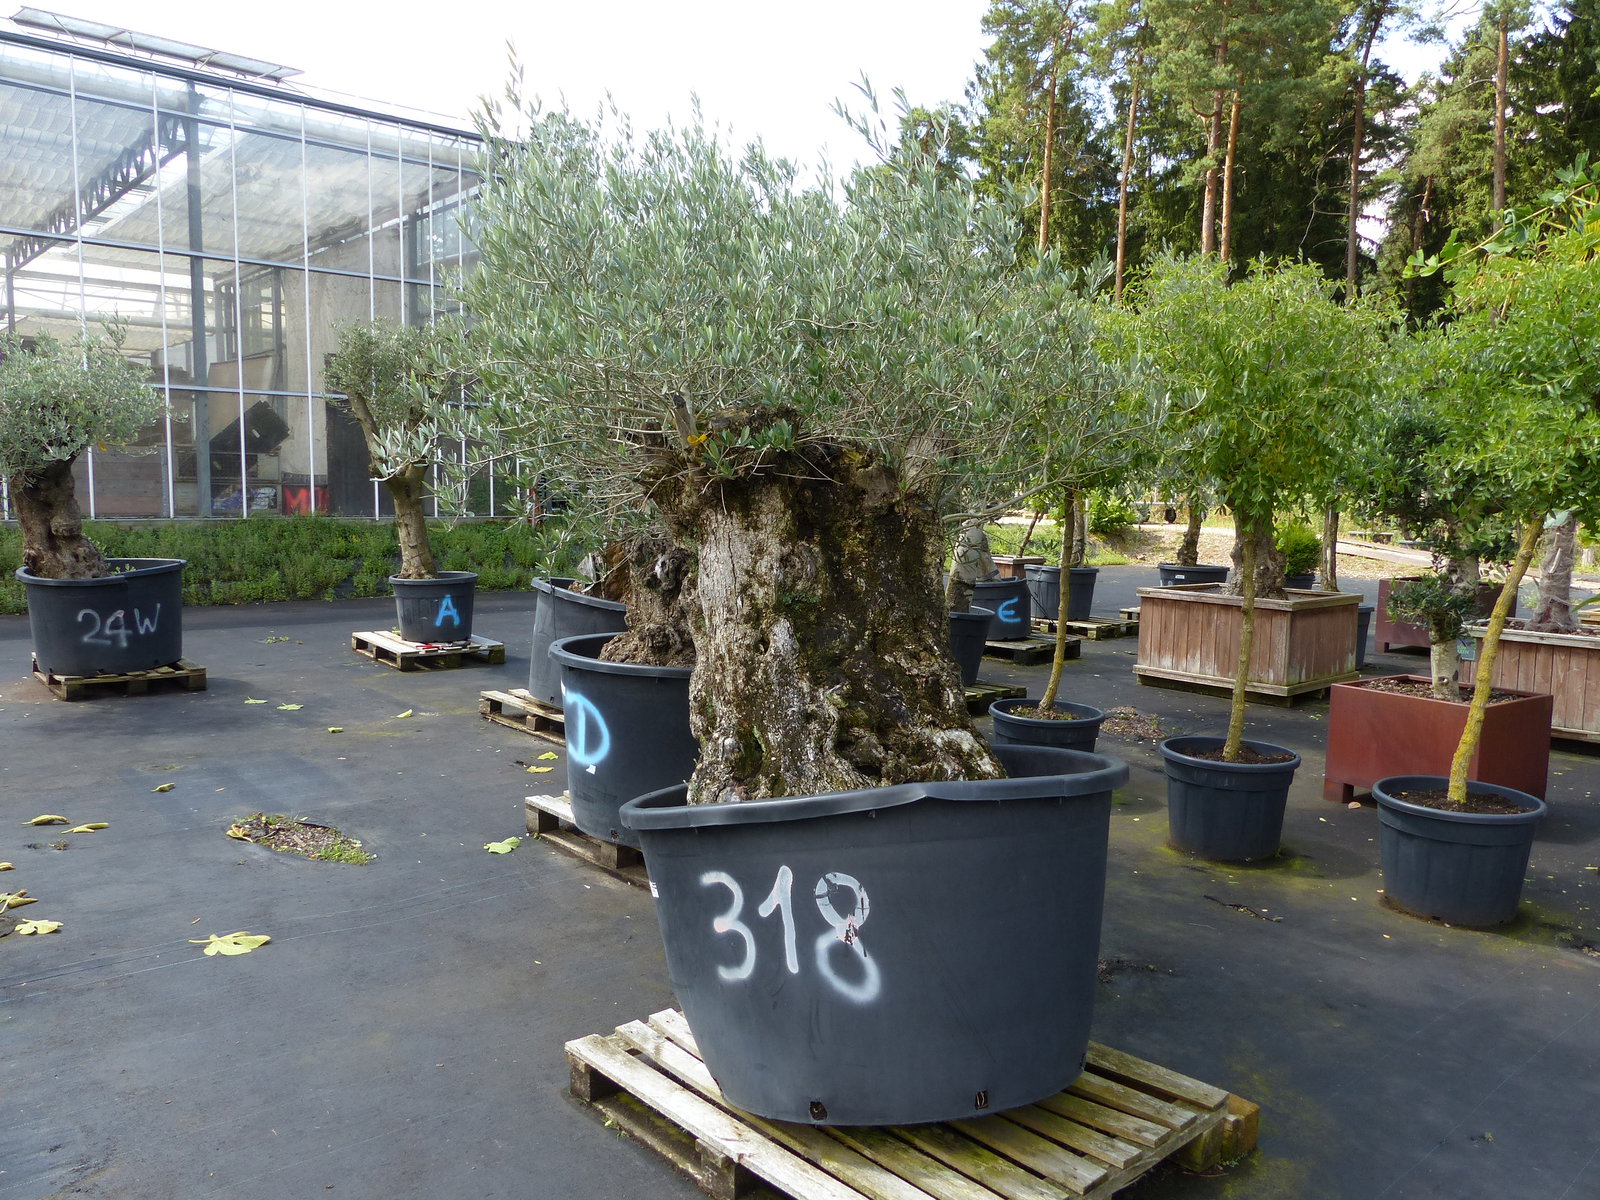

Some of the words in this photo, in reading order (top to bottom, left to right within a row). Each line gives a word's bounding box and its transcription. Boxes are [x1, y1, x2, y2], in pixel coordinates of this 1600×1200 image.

[77, 602, 161, 647] 24W
[435, 594, 460, 627] A
[997, 596, 1022, 623] E
[565, 690, 611, 765] D
[700, 865, 882, 1002] 318
